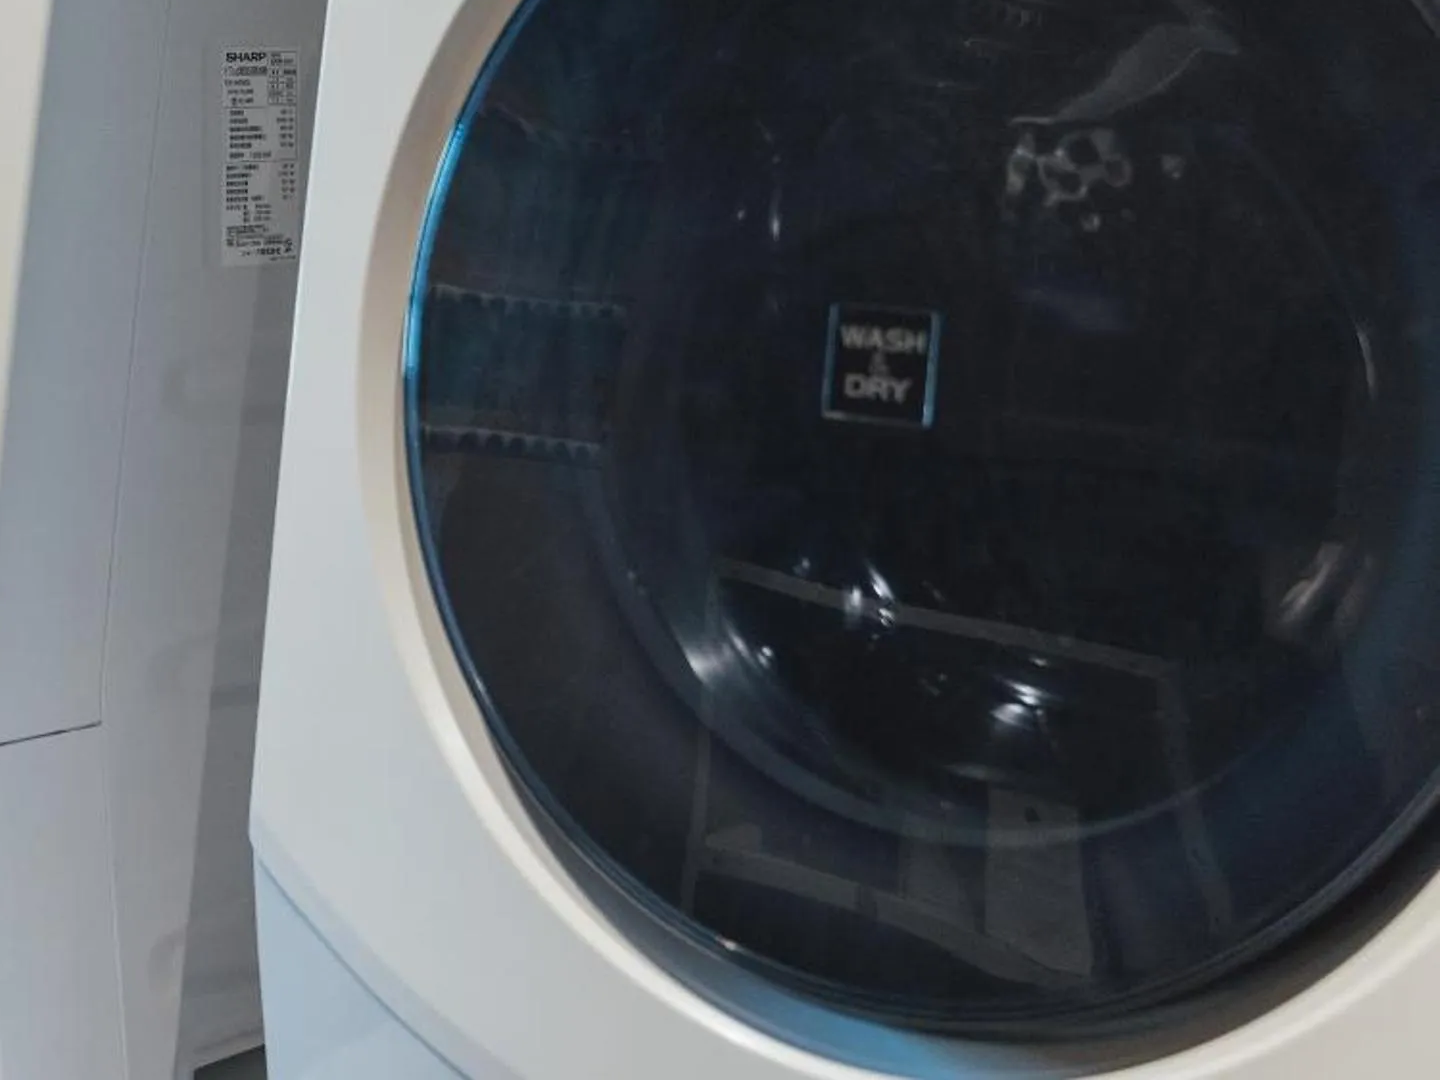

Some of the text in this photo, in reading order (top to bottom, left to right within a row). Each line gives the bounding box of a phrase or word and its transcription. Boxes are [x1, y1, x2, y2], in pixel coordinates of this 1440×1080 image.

[225, 51, 268, 63] SHARP
[839, 324, 928, 355] WASH
[843, 372, 914, 404] DRY
